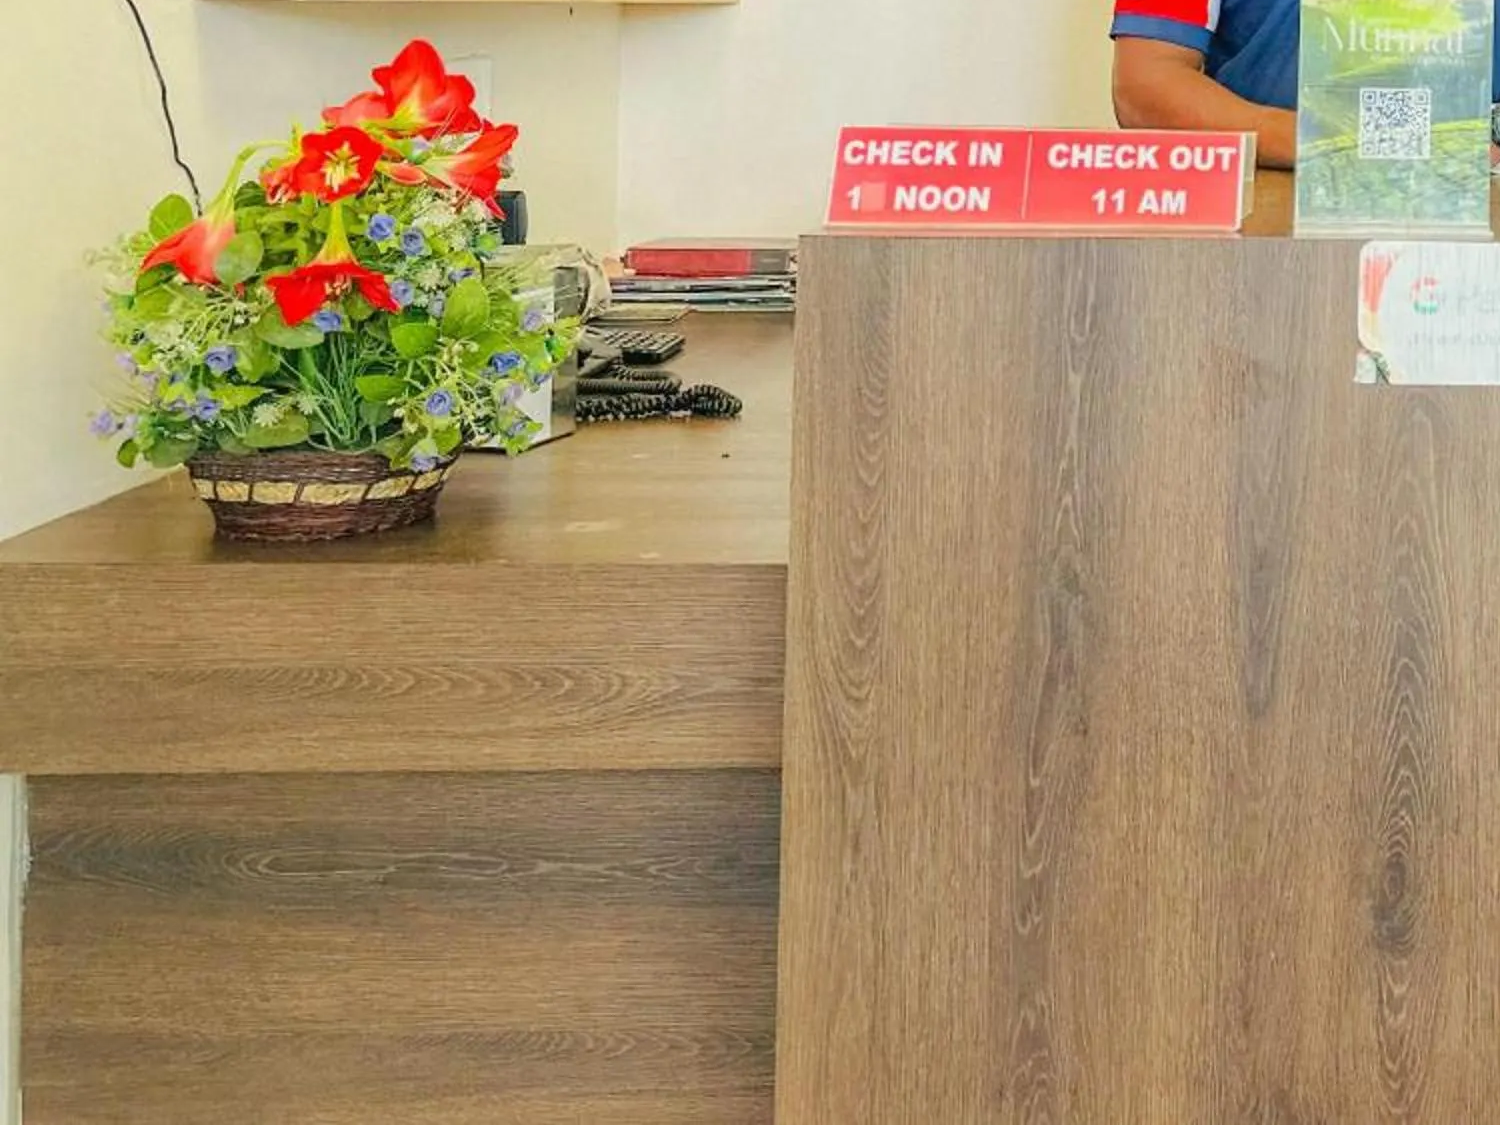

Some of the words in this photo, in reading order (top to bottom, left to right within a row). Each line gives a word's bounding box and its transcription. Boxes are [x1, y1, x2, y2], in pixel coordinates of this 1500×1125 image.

[843, 139, 959, 167] CHECK
[968, 141, 1004, 167] IN
[1047, 142, 1160, 170] CHECK
[1169, 145, 1237, 172] OUT
[893, 185, 992, 212] NOON
[1091, 188, 1126, 215] 11
[1137, 189, 1188, 215] AM
